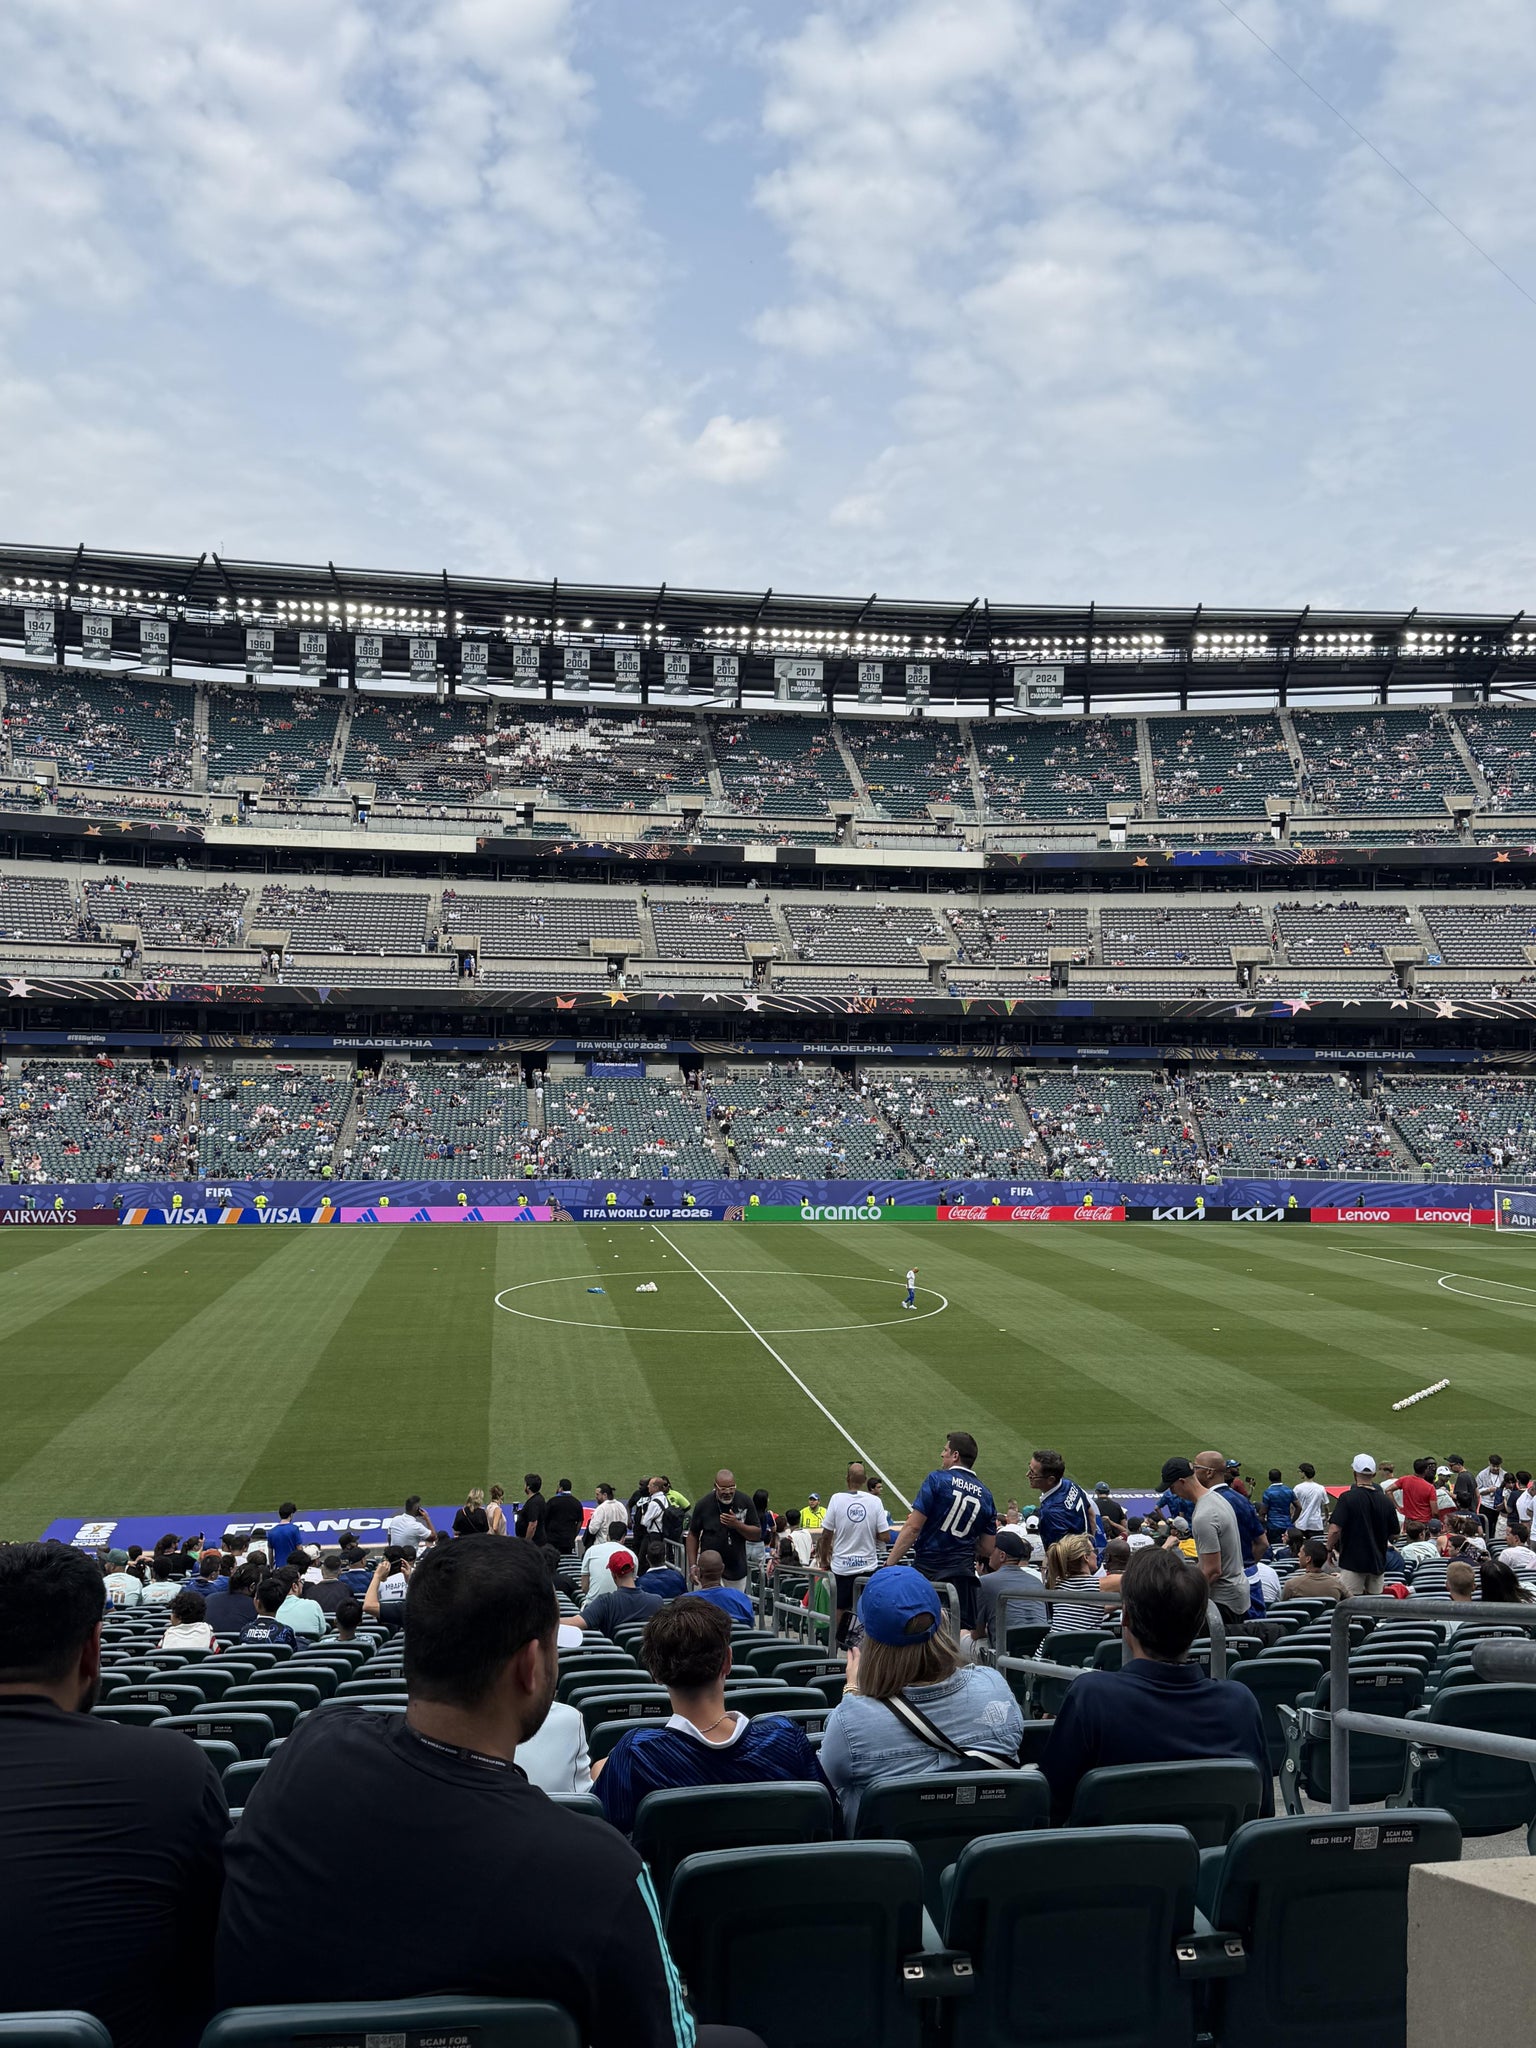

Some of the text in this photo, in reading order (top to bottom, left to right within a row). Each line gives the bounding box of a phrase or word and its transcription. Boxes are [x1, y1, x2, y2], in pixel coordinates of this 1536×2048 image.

[28, 621, 51, 630] 1947
[87, 626, 108, 636] 1948
[144, 632, 165, 642] 1949
[250, 640, 270, 649] 1960
[303, 643, 324, 653] 1980
[359, 646, 379, 656] 1988
[413, 650, 434, 659] 2001
[464, 653, 486, 662] 2002
[516, 656, 537, 665] 2003
[566, 659, 587, 668] 2004
[617, 661, 638, 670] 2006
[668, 663, 686, 672] 2010
[716, 666, 735, 674] 2013
[796, 667, 815, 677] 2017
[862, 673, 880, 681] 2019
[908, 675, 928, 683] 2022
[1036, 675, 1057, 683] 2024
[333, 1039, 433, 1047] PHILADELPHIA
[1315, 1051, 1415, 1059] PHILADELPHIA
[205, 1188, 233, 1197] FIFA
[1010, 1187, 1034, 1196] FIFA
[2, 1210, 76, 1223] AIRWAYS
[160, 1208, 207, 1224] VISA
[254, 1208, 301, 1224] VISA
[583, 1209, 607, 1218] FIFA
[608, 1209, 647, 1218] WORLD
[649, 1209, 670, 1218] CUP
[801, 1206, 881, 1221] aramco
[1337, 1209, 1390, 1221] Lenovo
[1415, 1209, 1471, 1222] Lenovo
[952, 1476, 982, 1497] MBAPPE
[940, 1489, 981, 1538] 10
[247, 1629, 270, 1639] MESSI
[1311, 1836, 1352, 1845] NEED HELP?
[1383, 1836, 1414, 1844] ASSISTANCE
[420, 2038, 446, 2047] SCAN
[449, 2036, 468, 2044] FOR
